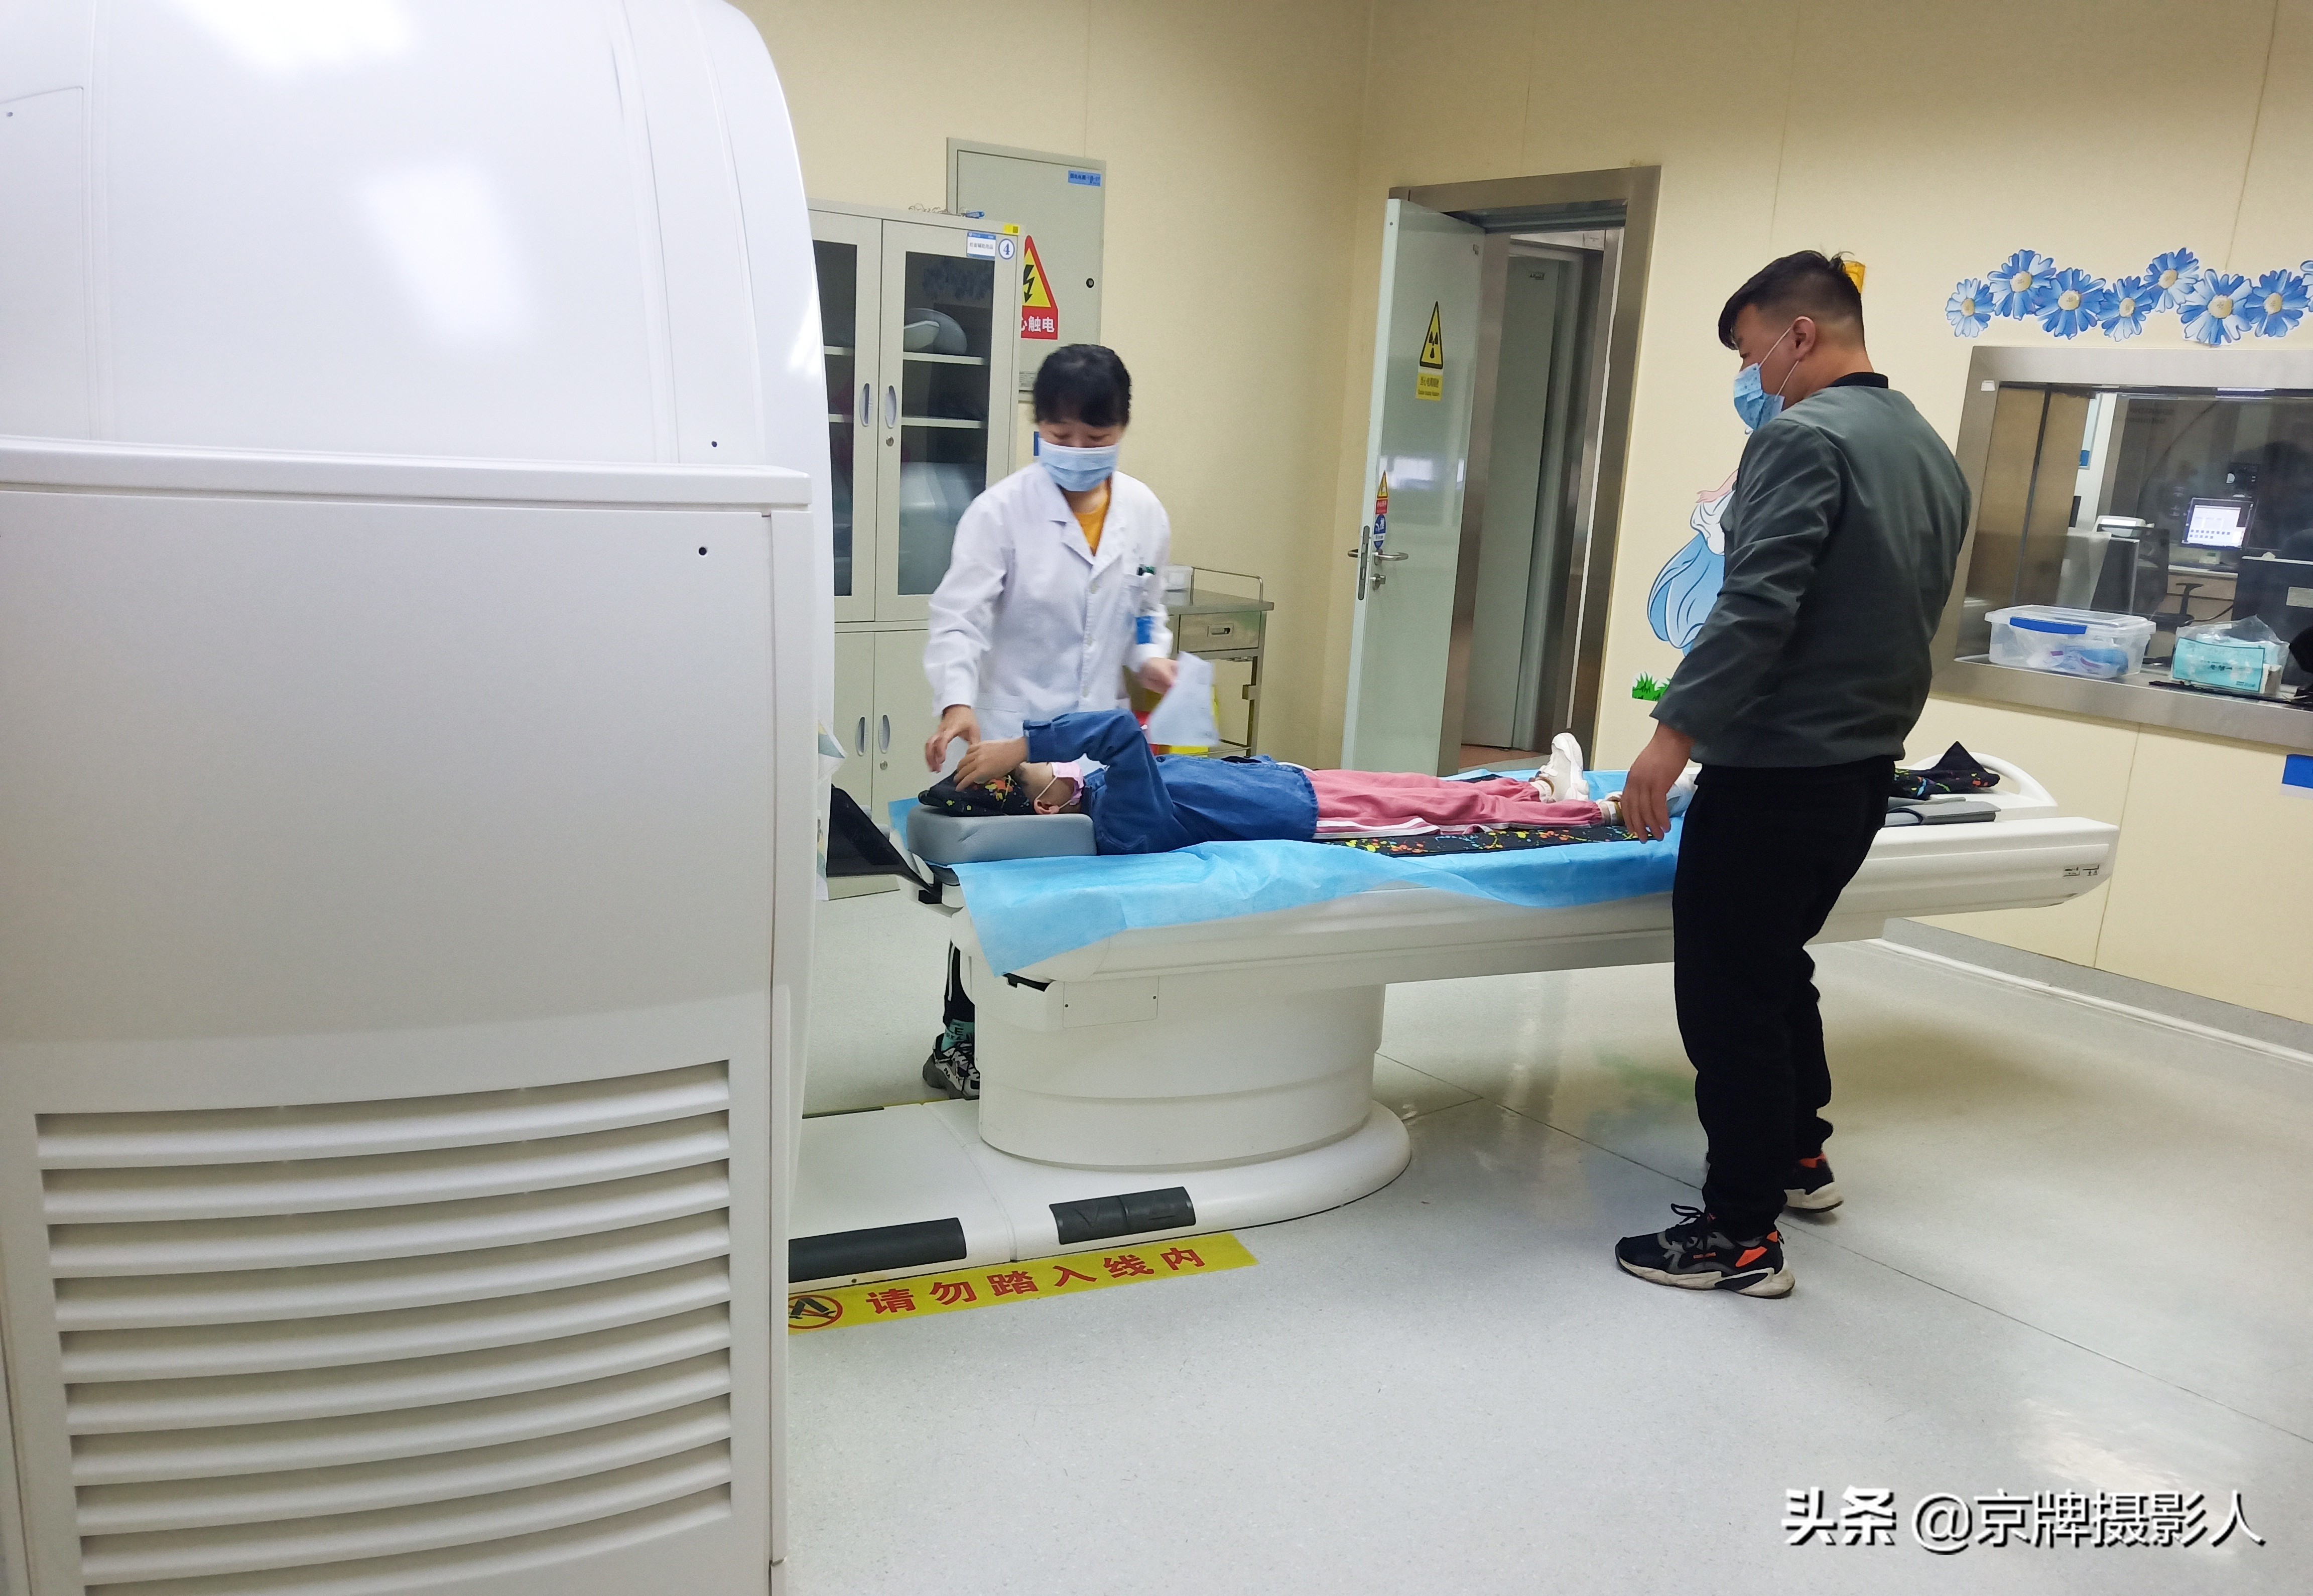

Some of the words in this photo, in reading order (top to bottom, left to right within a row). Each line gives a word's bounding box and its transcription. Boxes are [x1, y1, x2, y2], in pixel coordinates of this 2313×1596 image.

[1003, 243, 1010, 255] 4
[865, 1247, 1205, 1314] 请勿踏入线内
